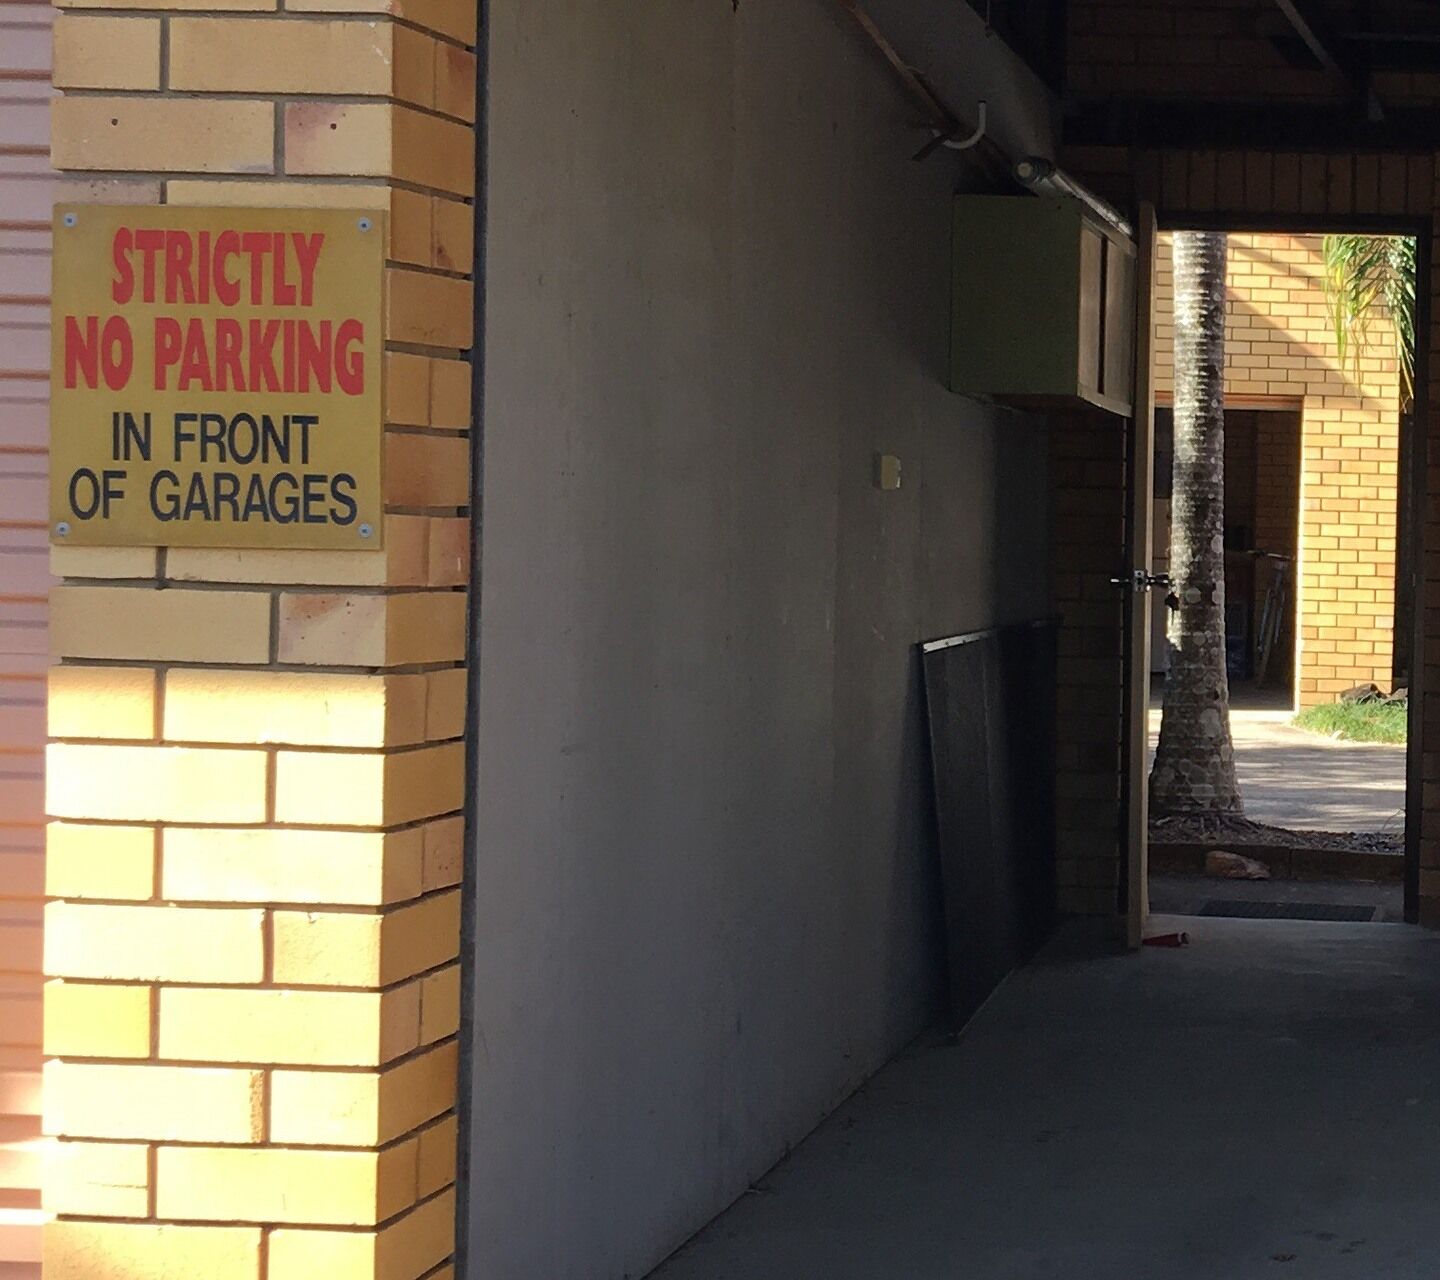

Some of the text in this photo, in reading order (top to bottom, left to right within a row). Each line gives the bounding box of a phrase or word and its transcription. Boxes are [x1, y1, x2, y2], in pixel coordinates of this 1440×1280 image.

[112, 227, 325, 306] STRICTLY
[65, 315, 365, 396] NO PARKING
[112, 412, 319, 464] IN FRONT
[69, 468, 357, 526] OF GARAGES
